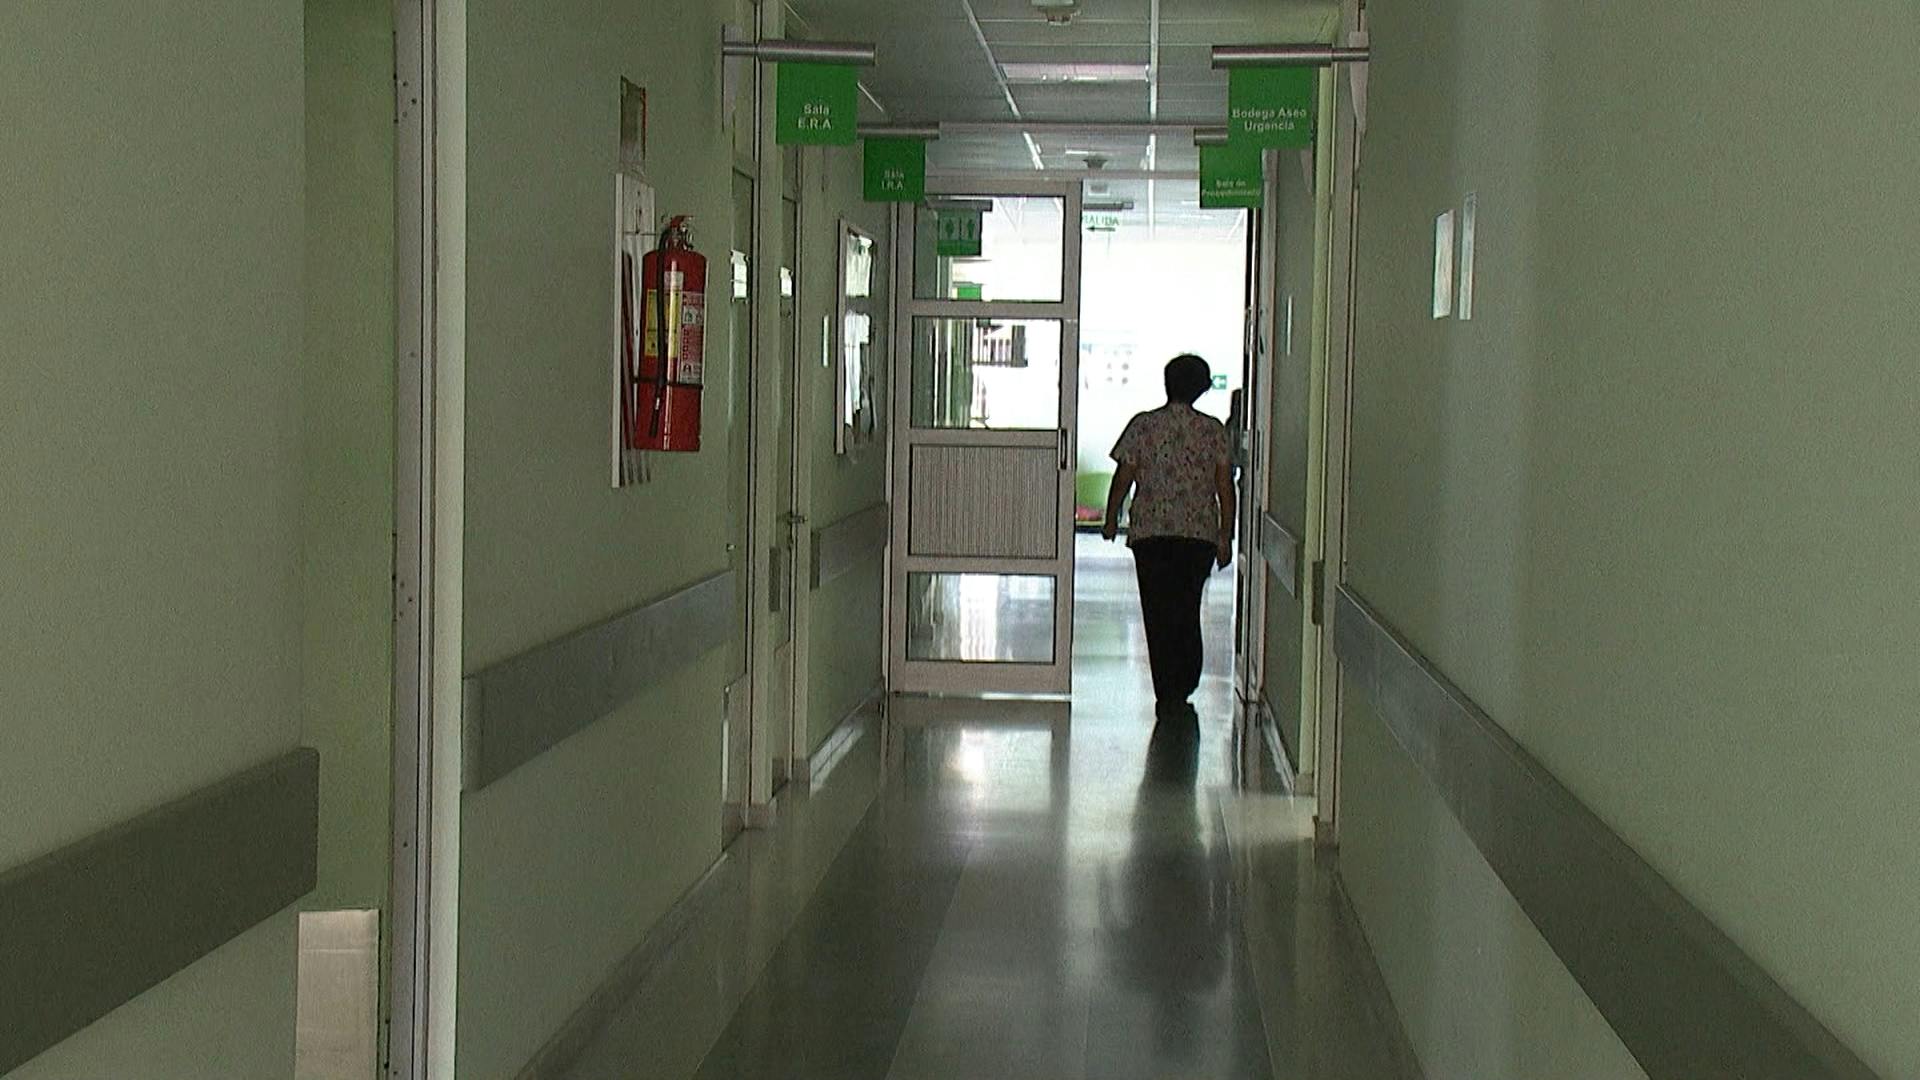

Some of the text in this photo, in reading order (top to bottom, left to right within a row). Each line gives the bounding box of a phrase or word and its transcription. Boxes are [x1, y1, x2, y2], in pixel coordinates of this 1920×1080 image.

[803, 102, 830, 115] Sala
[1232, 107, 1307, 120] Bodega Aseo
[1244, 120, 1294, 132] Urgencia
[885, 170, 905, 179] Sala
